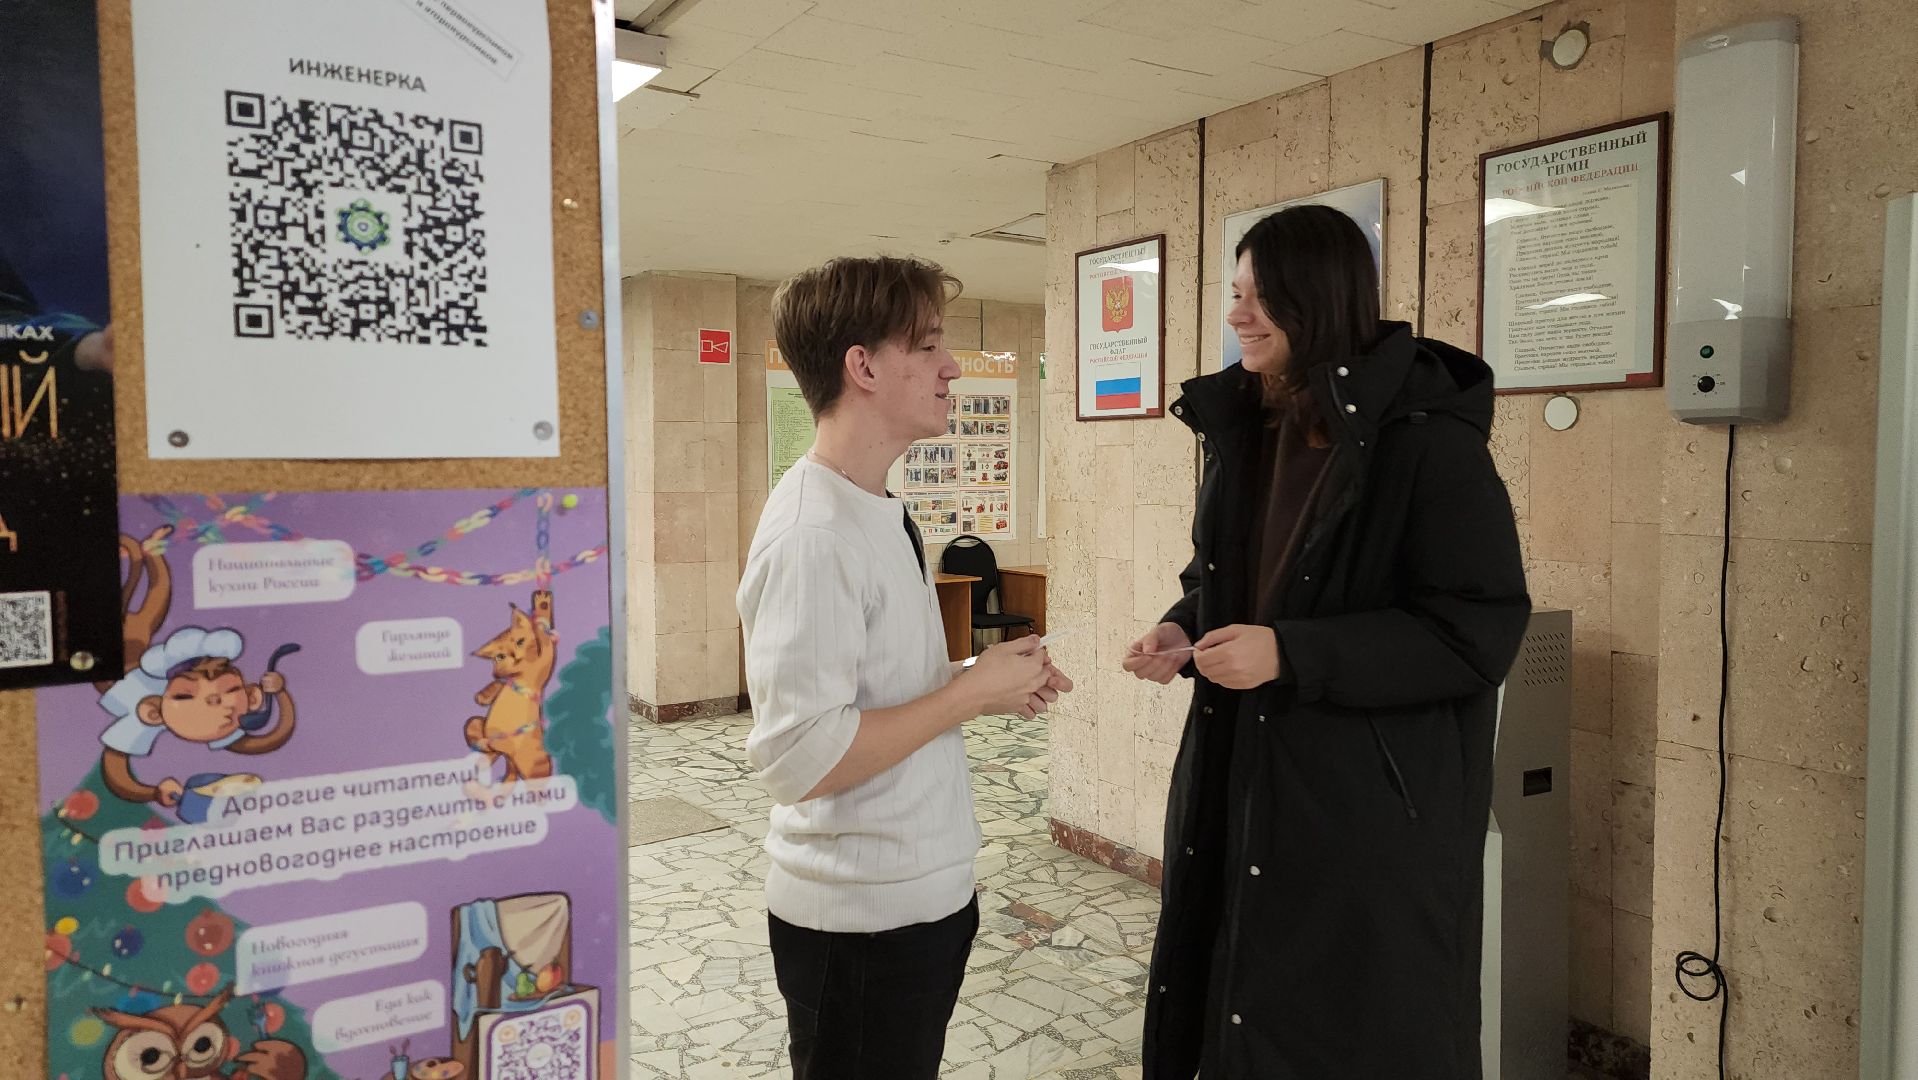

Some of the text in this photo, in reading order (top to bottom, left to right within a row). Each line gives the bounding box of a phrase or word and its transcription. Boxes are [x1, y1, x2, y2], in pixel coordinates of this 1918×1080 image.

[289, 57, 426, 92] ИНЖЕНЕРКА
[1496, 131, 1648, 175] ГОСУДАРСТВЕННЫЙ
[1546, 159, 1590, 177] ГИМН
[1571, 162, 1639, 184] ФЕДЕРАЦИИ
[1089, 336, 1148, 351] ГОСУДАРСТВЕННЫЙ
[953, 356, 1015, 374] НОСТЬ
[263, 576, 320, 590] России
[222, 765, 480, 818] Дорогие читатели!
[114, 786, 567, 864] Приглашаем Вас разделить с нами
[156, 819, 537, 892] предновогоднее настроение
[251, 929, 348, 956] Новогодняя
[251, 937, 420, 978] книжная дегустация
[406, 988, 432, 1004] как
